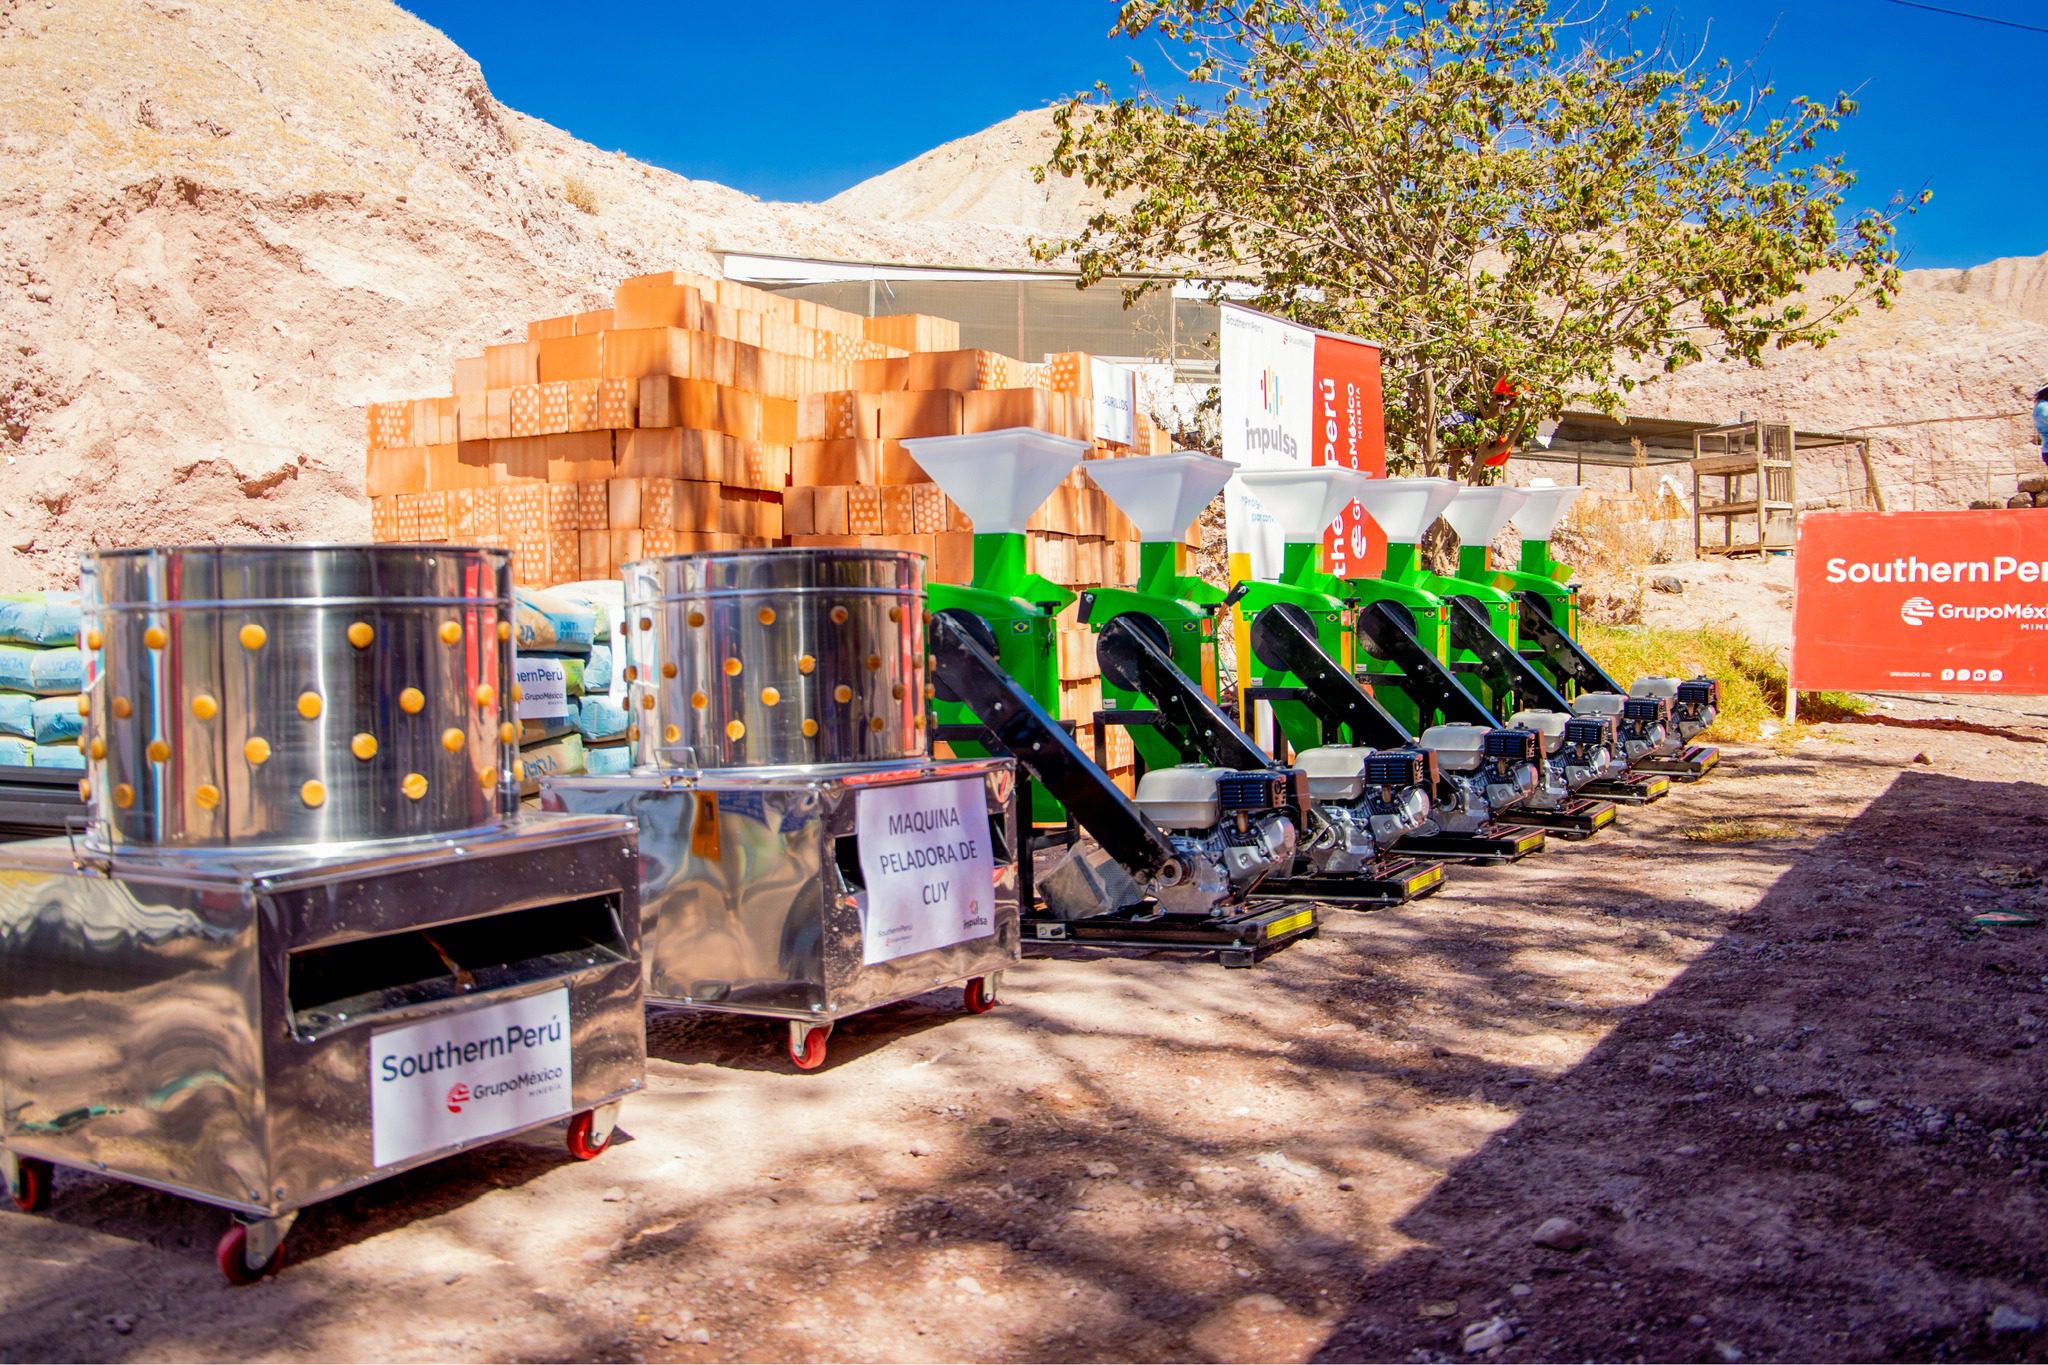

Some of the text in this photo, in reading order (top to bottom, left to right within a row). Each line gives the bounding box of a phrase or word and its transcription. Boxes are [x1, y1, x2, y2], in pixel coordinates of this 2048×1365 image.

[1245, 417, 1297, 460] impulsa
[889, 807, 960, 836] MAQUINA
[880, 840, 977, 875] PELADORA DE
[922, 881, 949, 905] CUY
[381, 1015, 561, 1082] SouthernPerú
[473, 1066, 563, 1100] GrupoMéxico
